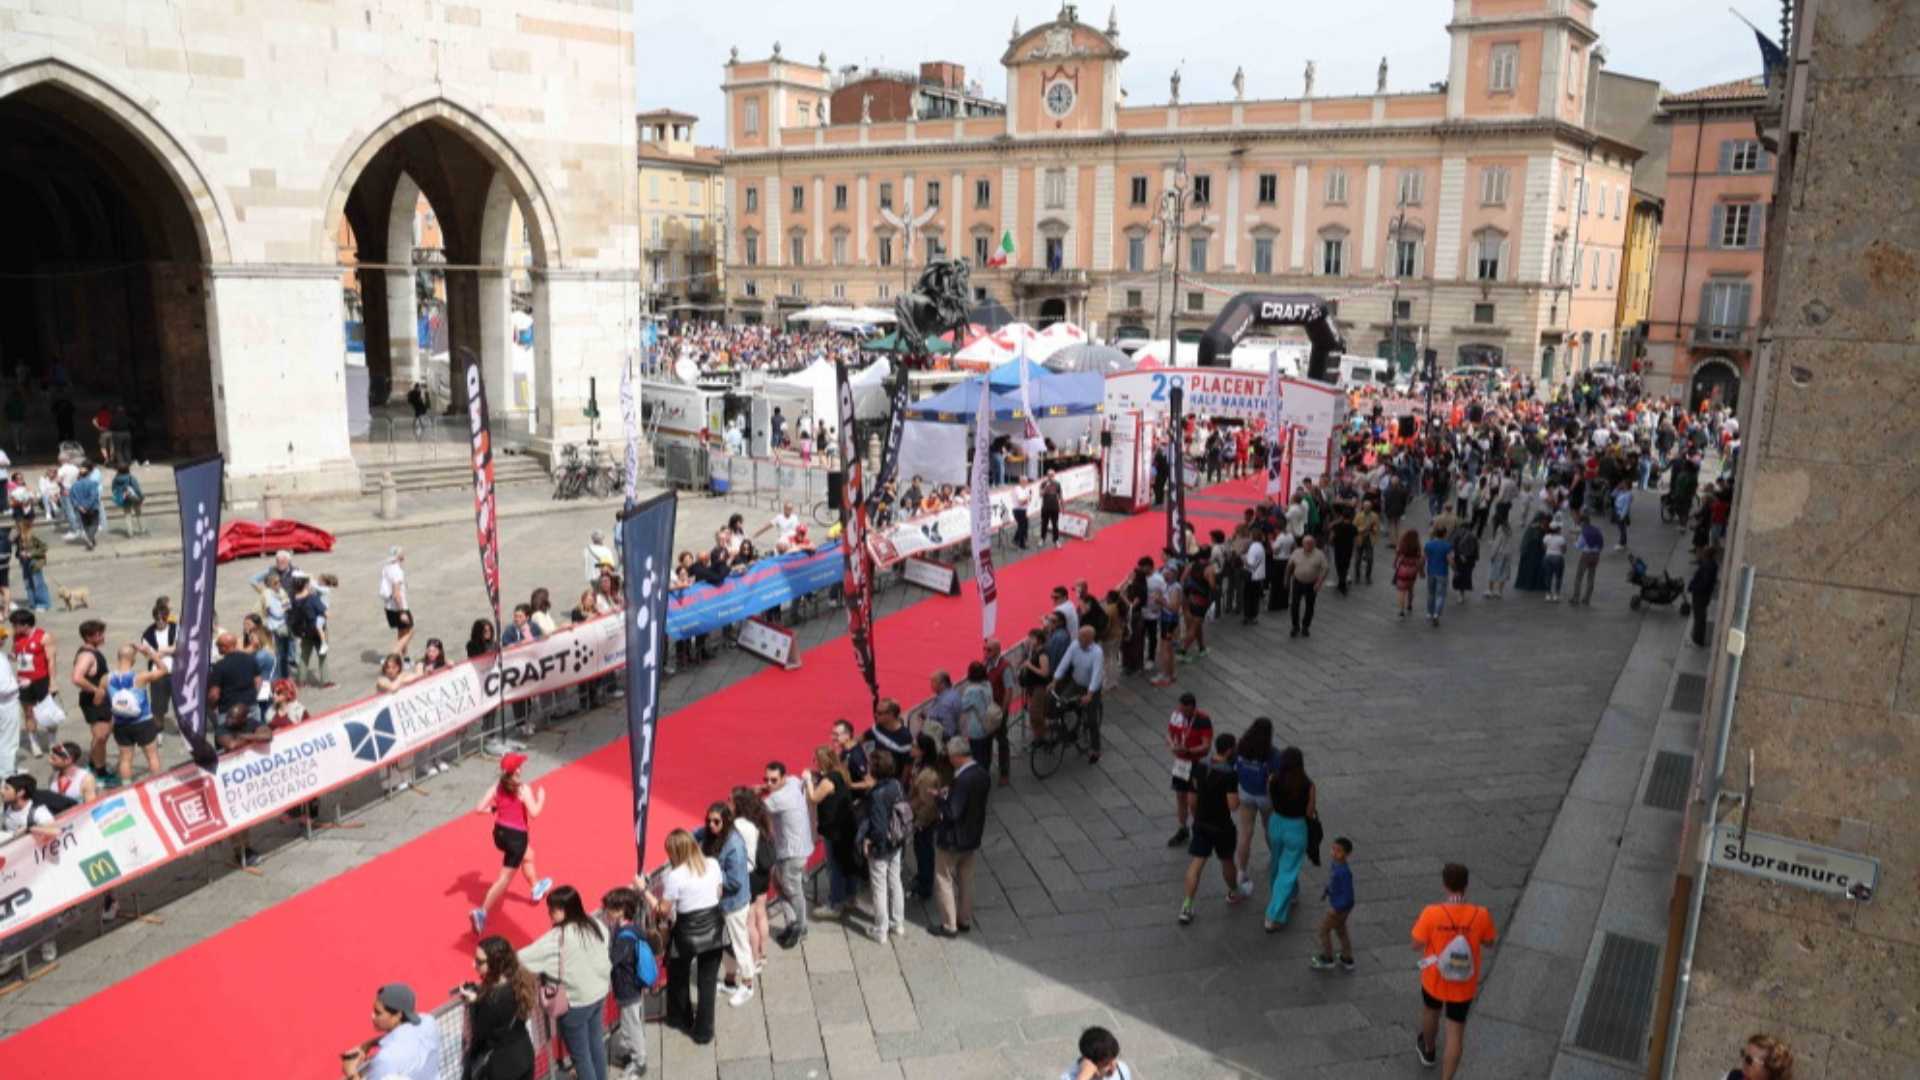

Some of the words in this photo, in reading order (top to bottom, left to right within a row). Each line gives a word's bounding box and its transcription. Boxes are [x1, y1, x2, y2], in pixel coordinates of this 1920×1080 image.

[1261, 301, 1310, 320] CRAFT
[1191, 374, 1284, 397] PLACENTA
[483, 649, 571, 697] CRAFT
[221, 732, 337, 788] FONDAZIONE
[224, 786, 242, 805] DI
[245, 758, 319, 795] PIACENZA
[242, 773, 319, 813] VIGEVANO
